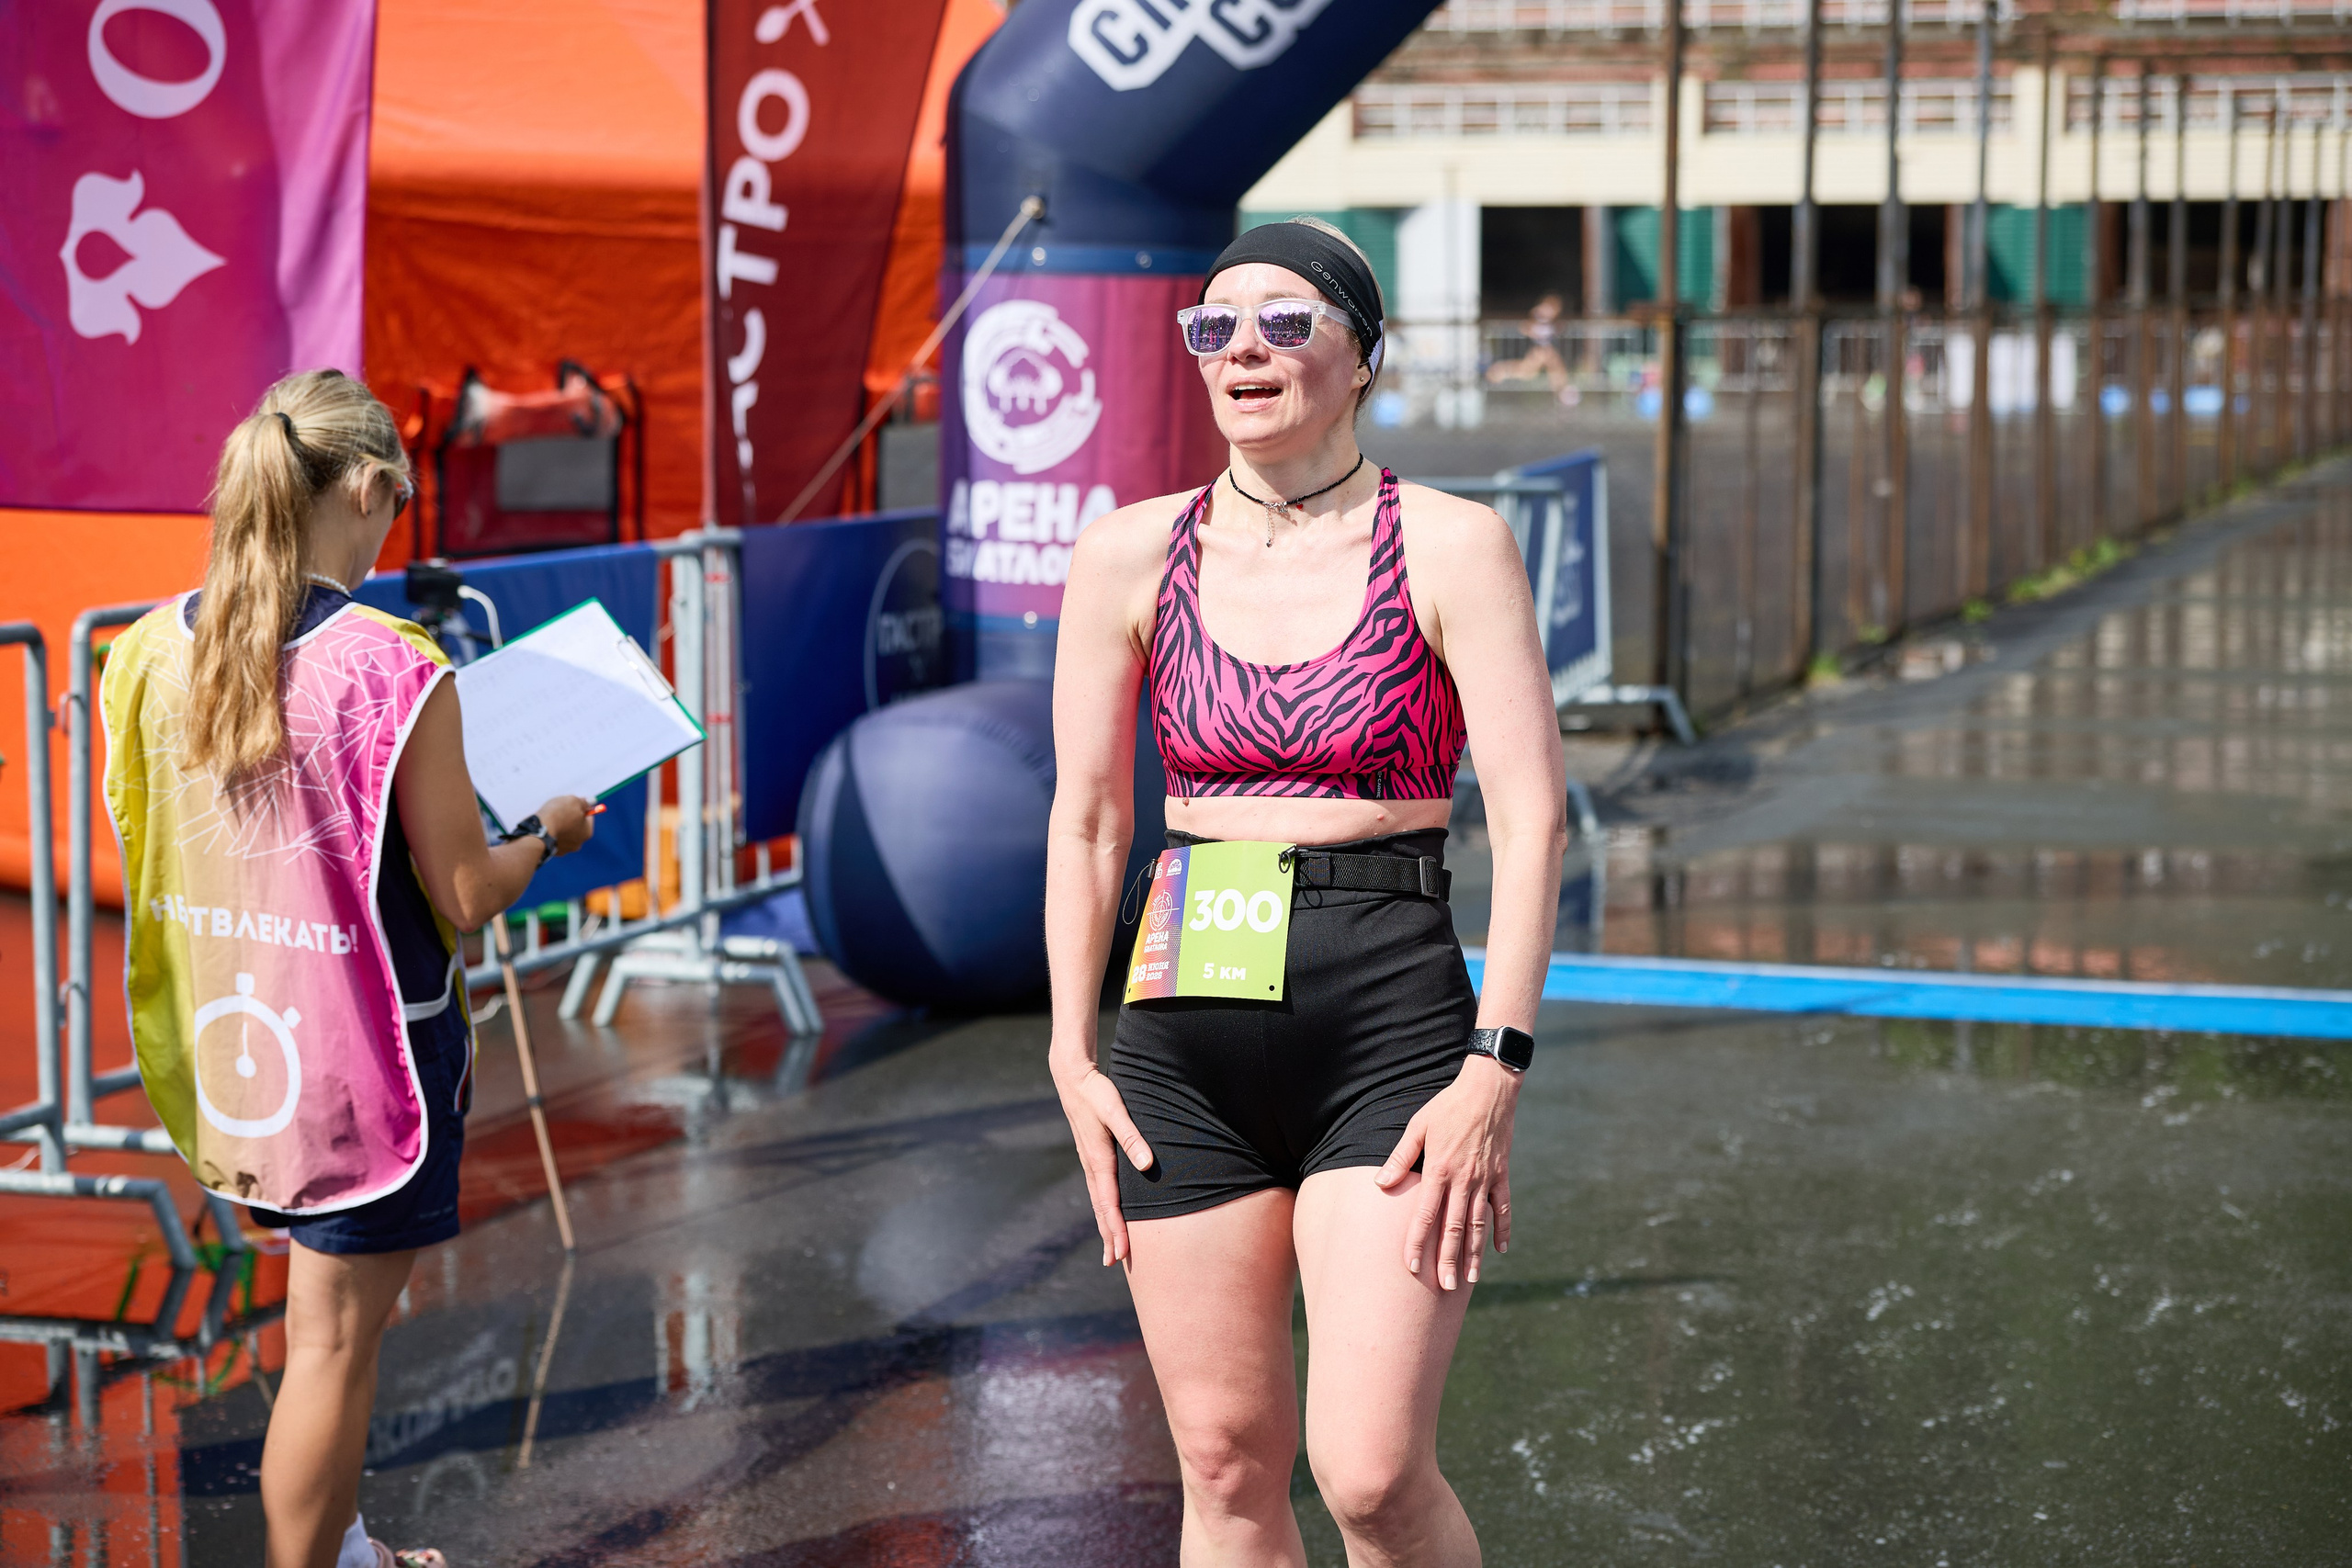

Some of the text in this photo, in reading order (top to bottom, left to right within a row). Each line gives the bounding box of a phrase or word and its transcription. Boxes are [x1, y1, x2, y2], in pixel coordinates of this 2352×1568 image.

[945, 537, 1070, 586] БИАТЛО
[1188, 888, 1283, 933] 300
[185, 906, 358, 954] ТВЛЕКАТЬ!
[1145, 931, 1170, 944] АРЕНА
[1131, 964, 1148, 984] 28
[1203, 963, 1215, 979] 5
